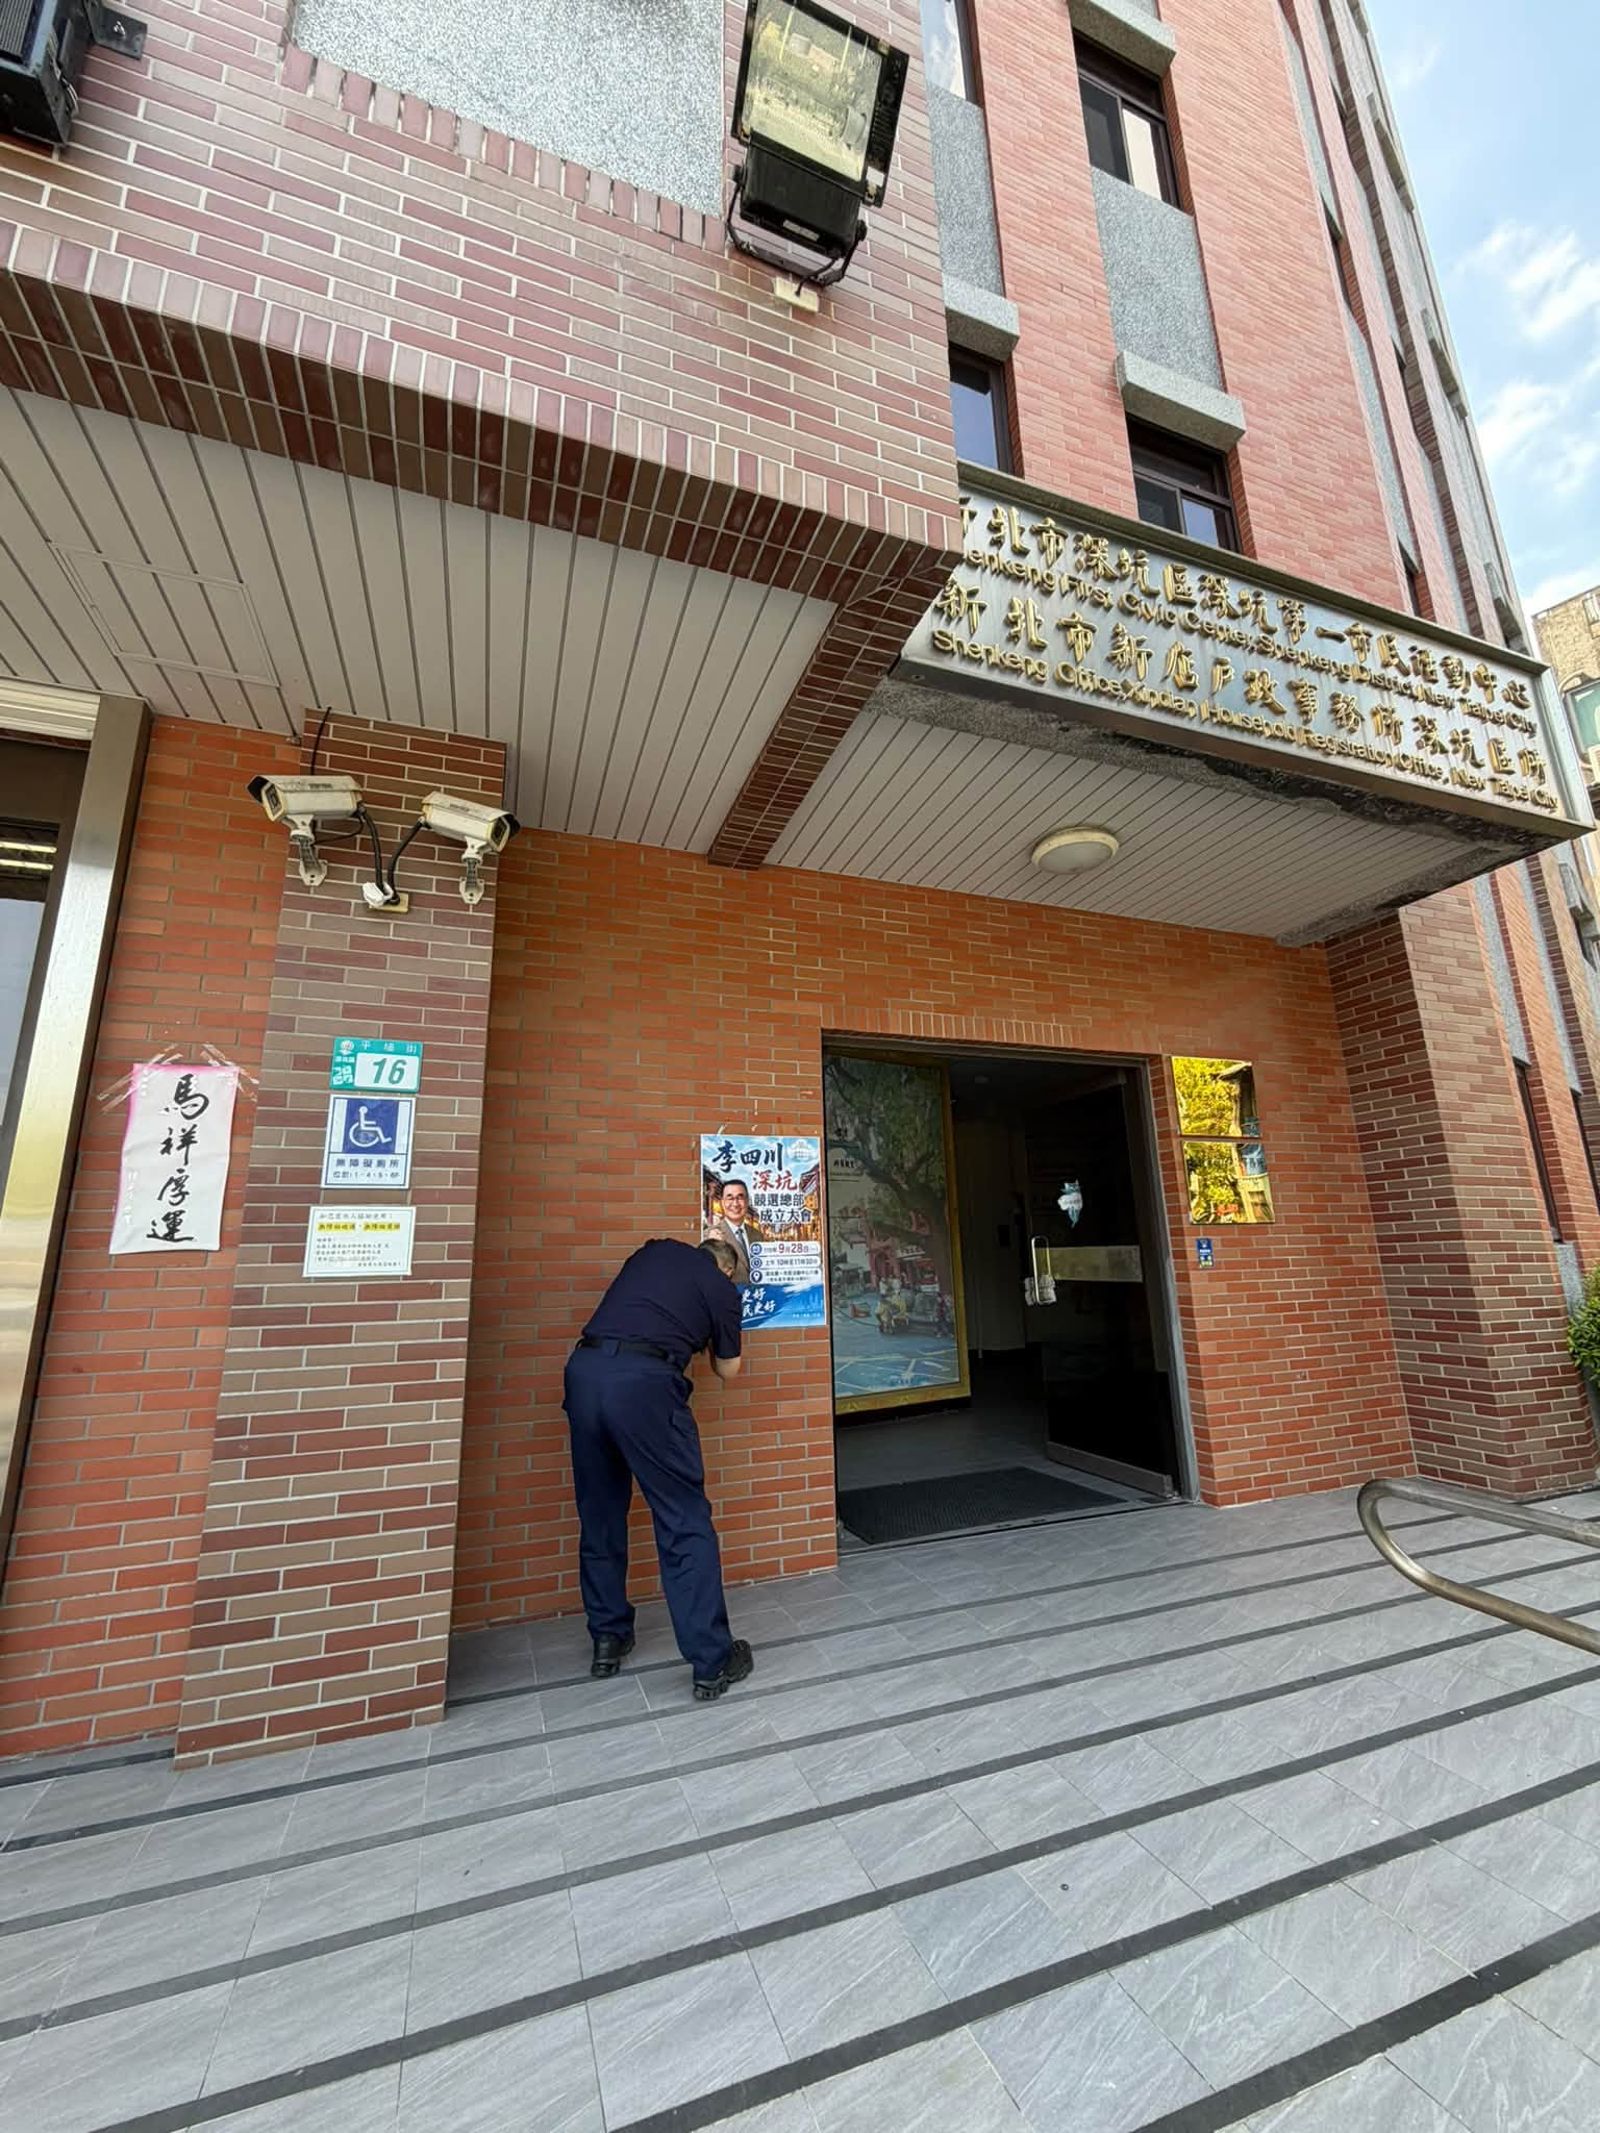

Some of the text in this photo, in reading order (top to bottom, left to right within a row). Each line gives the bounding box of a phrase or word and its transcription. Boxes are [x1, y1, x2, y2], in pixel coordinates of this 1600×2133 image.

[1059, 573, 1113, 609] First
[1119, 592, 1178, 626] Civic
[1256, 633, 1351, 682] Shenkeng
[1415, 684, 1455, 710] New
[1457, 698, 1506, 724] Taipei
[1505, 713, 1537, 739] City
[931, 629, 1049, 683] Shenkeng
[1200, 699, 1298, 742] Household
[1297, 726, 1395, 769] Registration
[1449, 767, 1486, 791] New
[1487, 777, 1532, 803] Taipei
[1530, 789, 1558, 813] City
[372, 1057, 407, 1085] 16
[712, 1140, 784, 1173] 李四川
[752, 1170, 798, 1192] 深坑
[754, 1193, 805, 1208] 競選總部
[760, 1208, 812, 1224] 成立大會
